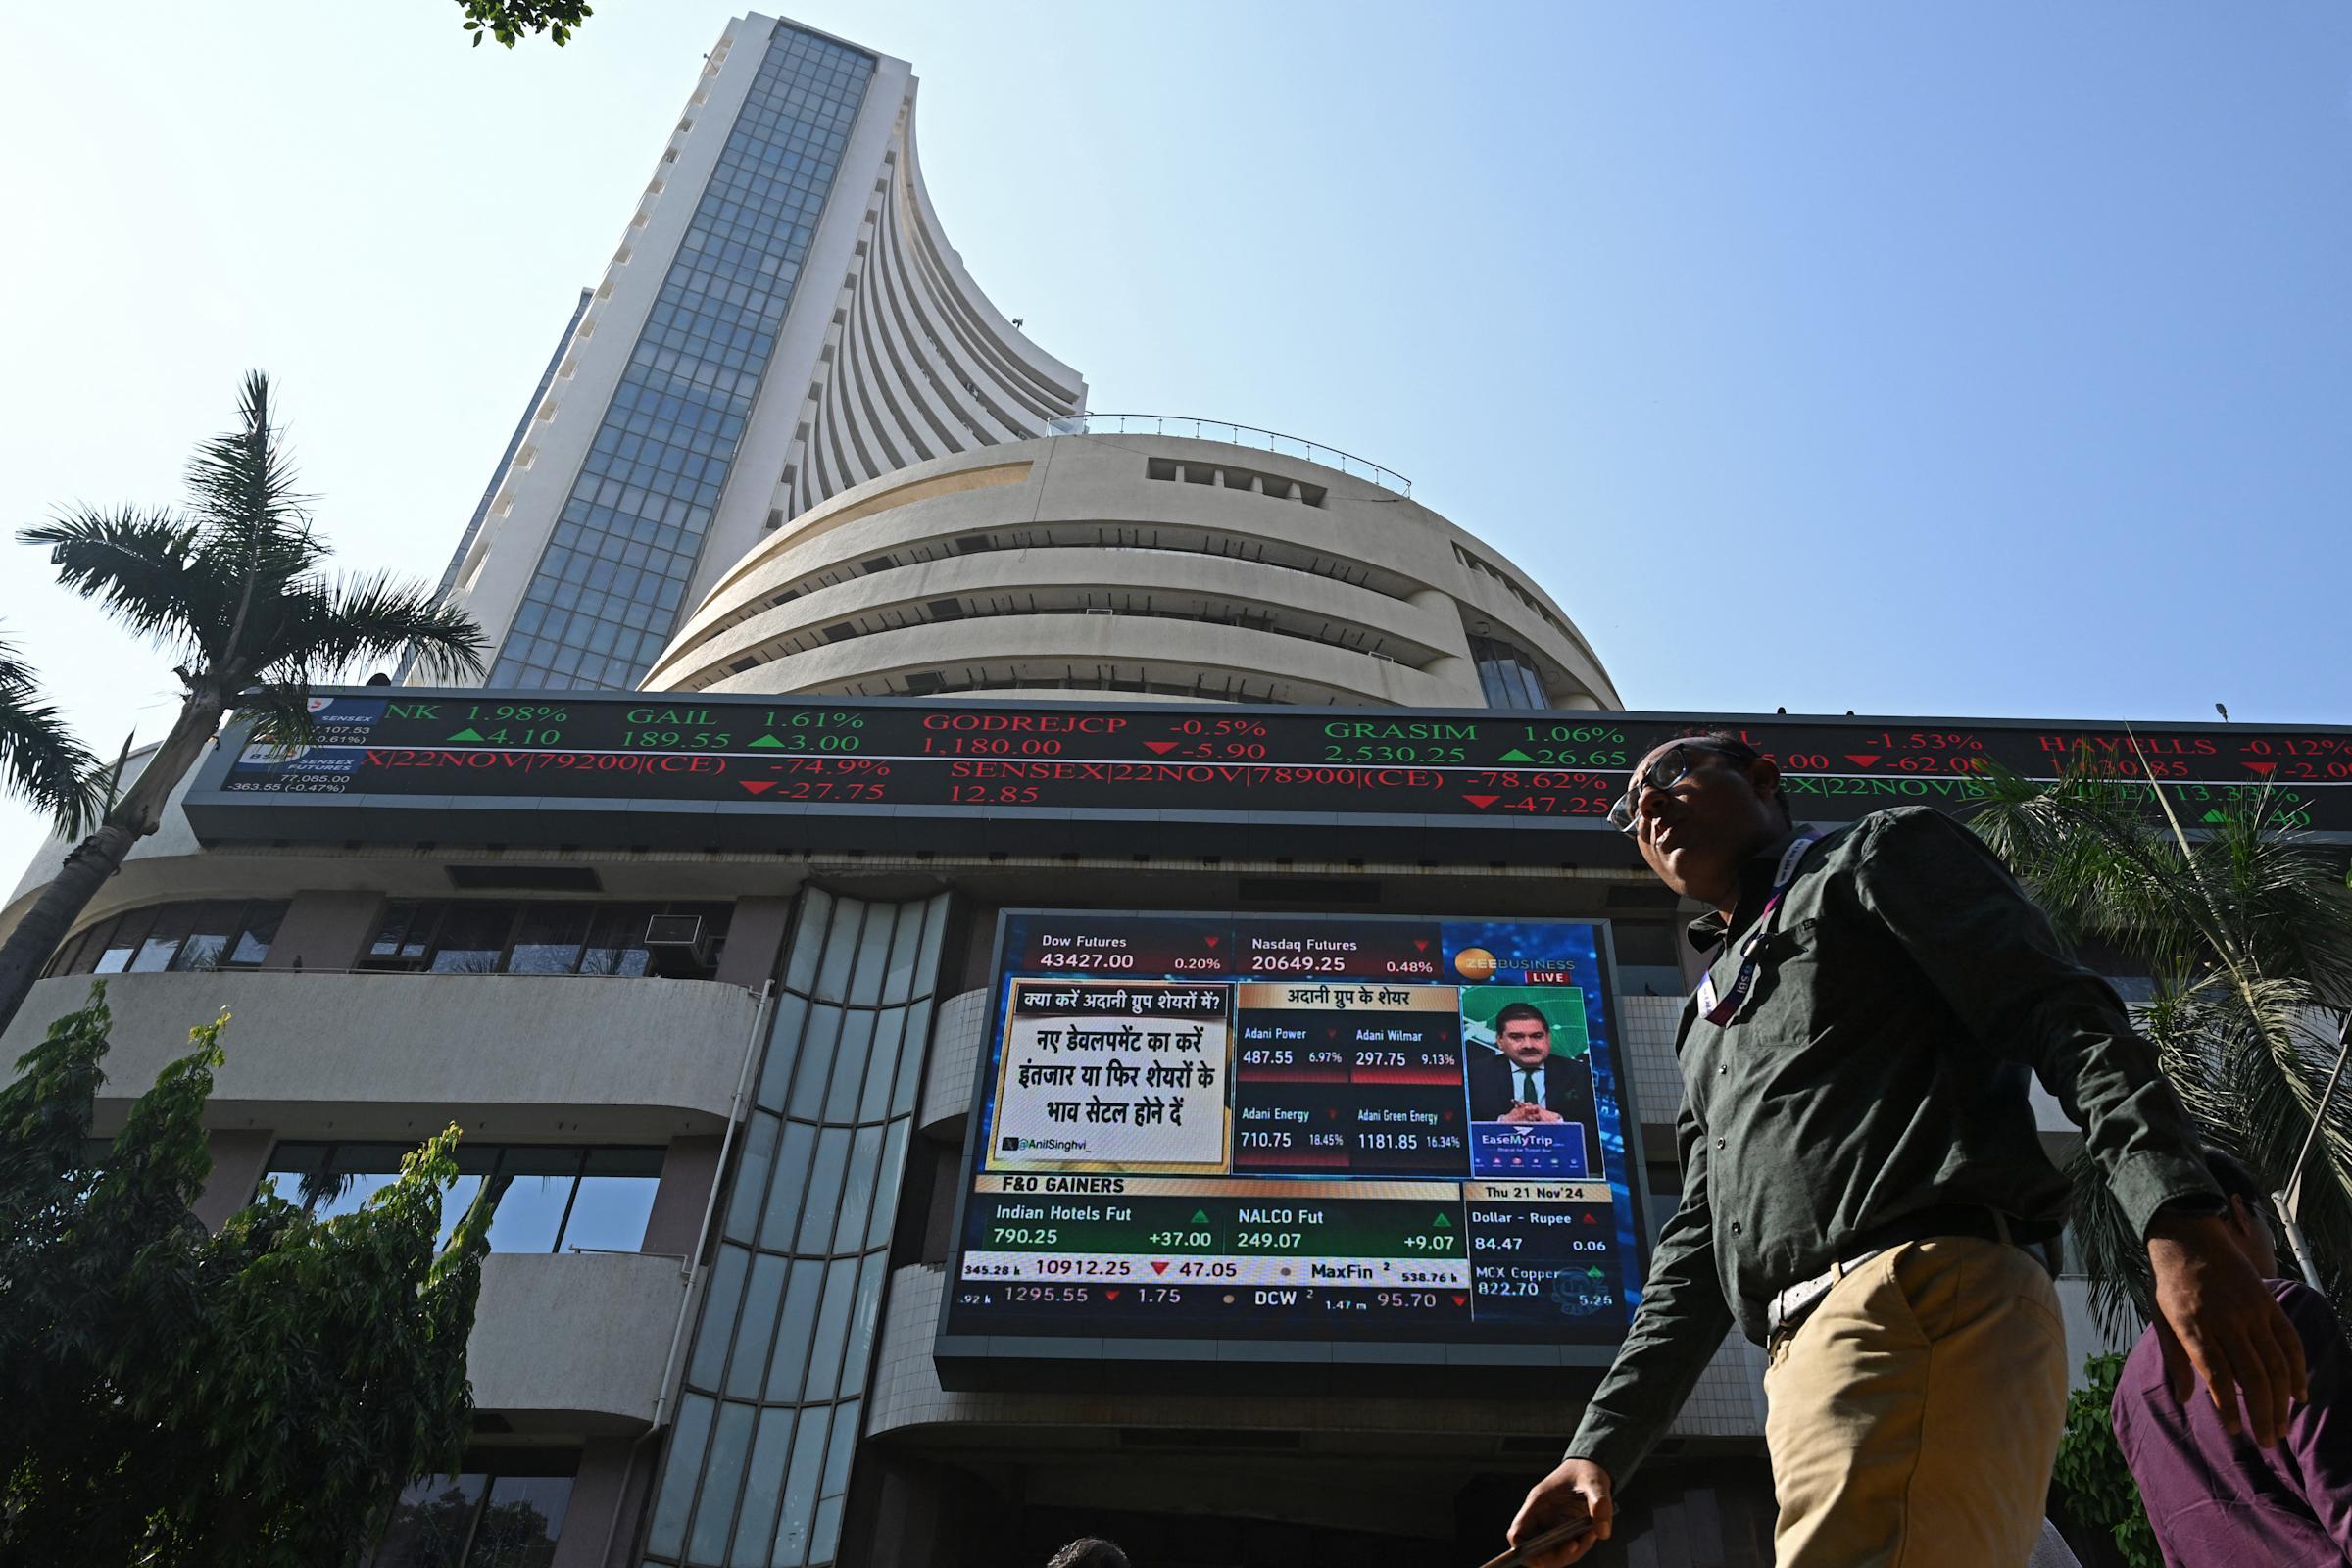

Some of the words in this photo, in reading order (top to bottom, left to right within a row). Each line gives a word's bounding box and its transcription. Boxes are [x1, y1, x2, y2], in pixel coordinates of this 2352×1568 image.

[466, 705, 568, 723] 1.98%
[627, 708, 719, 726] GAIL
[762, 710, 865, 730] 1.61%
[923, 714, 1128, 734] GODREJCP
[1169, 719, 1267, 737] -0.5%
[1324, 722, 1479, 740] GRASIM
[1523, 726, 1625, 744] 1.06%
[486, 728, 562, 745] 4.10
[621, 731, 732, 749] 189.55
[787, 735, 860, 752] 3.00
[1865, 733, 1984, 751] -1.53%
[923, 737, 1062, 756] 1,180.00
[1181, 742, 1267, 760] -5.90
[1324, 746, 1467, 763] 2,530.25
[1536, 749, 1628, 766] 26.65
[769, 758, 891, 777] -74.9%
[227, 783, 281, 792] -363.55
[284, 783, 346, 793] (-0.47%)
[280, 774, 351, 784] 77,085.00
[1467, 772, 1608, 791] -78.62%
[777, 783, 887, 801] -27.75
[948, 784, 1041, 804] 12.85
[1503, 796, 1610, 814] -47.25
[1042, 935, 1071, 947] Dow
[1076, 935, 1127, 948] Futures
[1251, 938, 1301, 953] Nasdaq
[1306, 938, 1358, 951] Futures
[1040, 953, 1134, 968] 43427.00
[1174, 957, 1221, 970] 0.20%
[1251, 956, 1346, 971] 20649.25
[1386, 961, 1434, 973] 0.48%
[1533, 972, 1564, 983] LIVE
[1024, 991, 1052, 1007] क्या
[1055, 988, 1080, 1008] करें
[1082, 989, 1128, 1009] अदानी
[1131, 993, 1153, 1014] ग्रुप
[1157, 990, 1198, 1010] शेयरों
[1288, 985, 1330, 1004] अदानी
[1334, 989, 1355, 1008] ग्रुप
[1358, 986, 1374, 1004] के
[1378, 987, 1410, 1005] शेयर
[1037, 1029, 1062, 1054] नए
[1066, 1023, 1144, 1053] डेवलपमेंट
[1147, 1031, 1171, 1054] का
[1175, 1025, 1205, 1053] करें
[1244, 1027, 1272, 1040] Adani
[1275, 1028, 1307, 1041] Power
[1356, 1029, 1384, 1042] Adani
[1387, 1029, 1423, 1042] Wilmar
[1243, 1050, 1294, 1065] 487.55
[1309, 1052, 1342, 1064] 6.97%
[1355, 1052, 1406, 1066] 297.75
[1421, 1054, 1455, 1066] 9.13%
[1018, 1058, 1076, 1089] इंतजार
[1081, 1065, 1102, 1087] या
[1105, 1058, 1141, 1088] फिर
[1146, 1059, 1194, 1088] शेयरों
[1197, 1059, 1216, 1089] के
[1047, 1101, 1081, 1123] भाव
[1085, 1095, 1129, 1124] सेटल
[1133, 1096, 1166, 1127] होने
[1169, 1096, 1185, 1127] दें
[1242, 1107, 1271, 1120] Adani
[1274, 1108, 1310, 1123] Energy
[1357, 1109, 1381, 1122] Adani
[1384, 1109, 1407, 1122] Green
[1410, 1109, 1439, 1125] Energy
[1241, 1132, 1292, 1148] 710.75
[1309, 1133, 1344, 1146] 18.45%
[1358, 1133, 1418, 1150] 1181.85
[1426, 1135, 1461, 1149] 16.34%
[1481, 1134, 1554, 1147] EaseMyTrip
[1002, 1176, 1039, 1193] F&O
[1045, 1177, 1125, 1194] GAINERS
[1486, 1187, 1508, 1198] Thu
[1513, 1187, 1530, 1198] 21
[996, 1203, 1045, 1220] Indian
[1050, 1204, 1101, 1222] Hotels
[1105, 1205, 1132, 1222] Fut
[1238, 1208, 1293, 1225] NALCO
[1298, 1209, 1324, 1225] Fut
[1472, 1211, 1513, 1224] Dollar
[1530, 1212, 1572, 1226] Rupee
[993, 1227, 1058, 1245] 790.25
[1149, 1231, 1212, 1248] +37.00
[1237, 1232, 1302, 1249] 249.07
[1403, 1235, 1455, 1250] +9.07
[1474, 1237, 1523, 1250] 84.47
[1572, 1240, 1606, 1251] 0.06
[964, 1265, 1009, 1276] 345.28
[1035, 1258, 1132, 1277] 10912.25
[1179, 1261, 1237, 1278] 47.05
[1311, 1264, 1373, 1280] MaxFin
[1383, 1261, 1391, 1271] 2
[1475, 1266, 1506, 1279] MCX
[1511, 1266, 1560, 1282] Copper
[1004, 1286, 1088, 1302] 1295.55
[1138, 1288, 1181, 1304] 1.75
[1478, 1282, 1540, 1297] 822.70
[1253, 1290, 1298, 1306] DCW
[1306, 1290, 1314, 1299] 2
[1325, 1300, 1351, 1311] 1.47
[1377, 1293, 1437, 1308] 95.70
